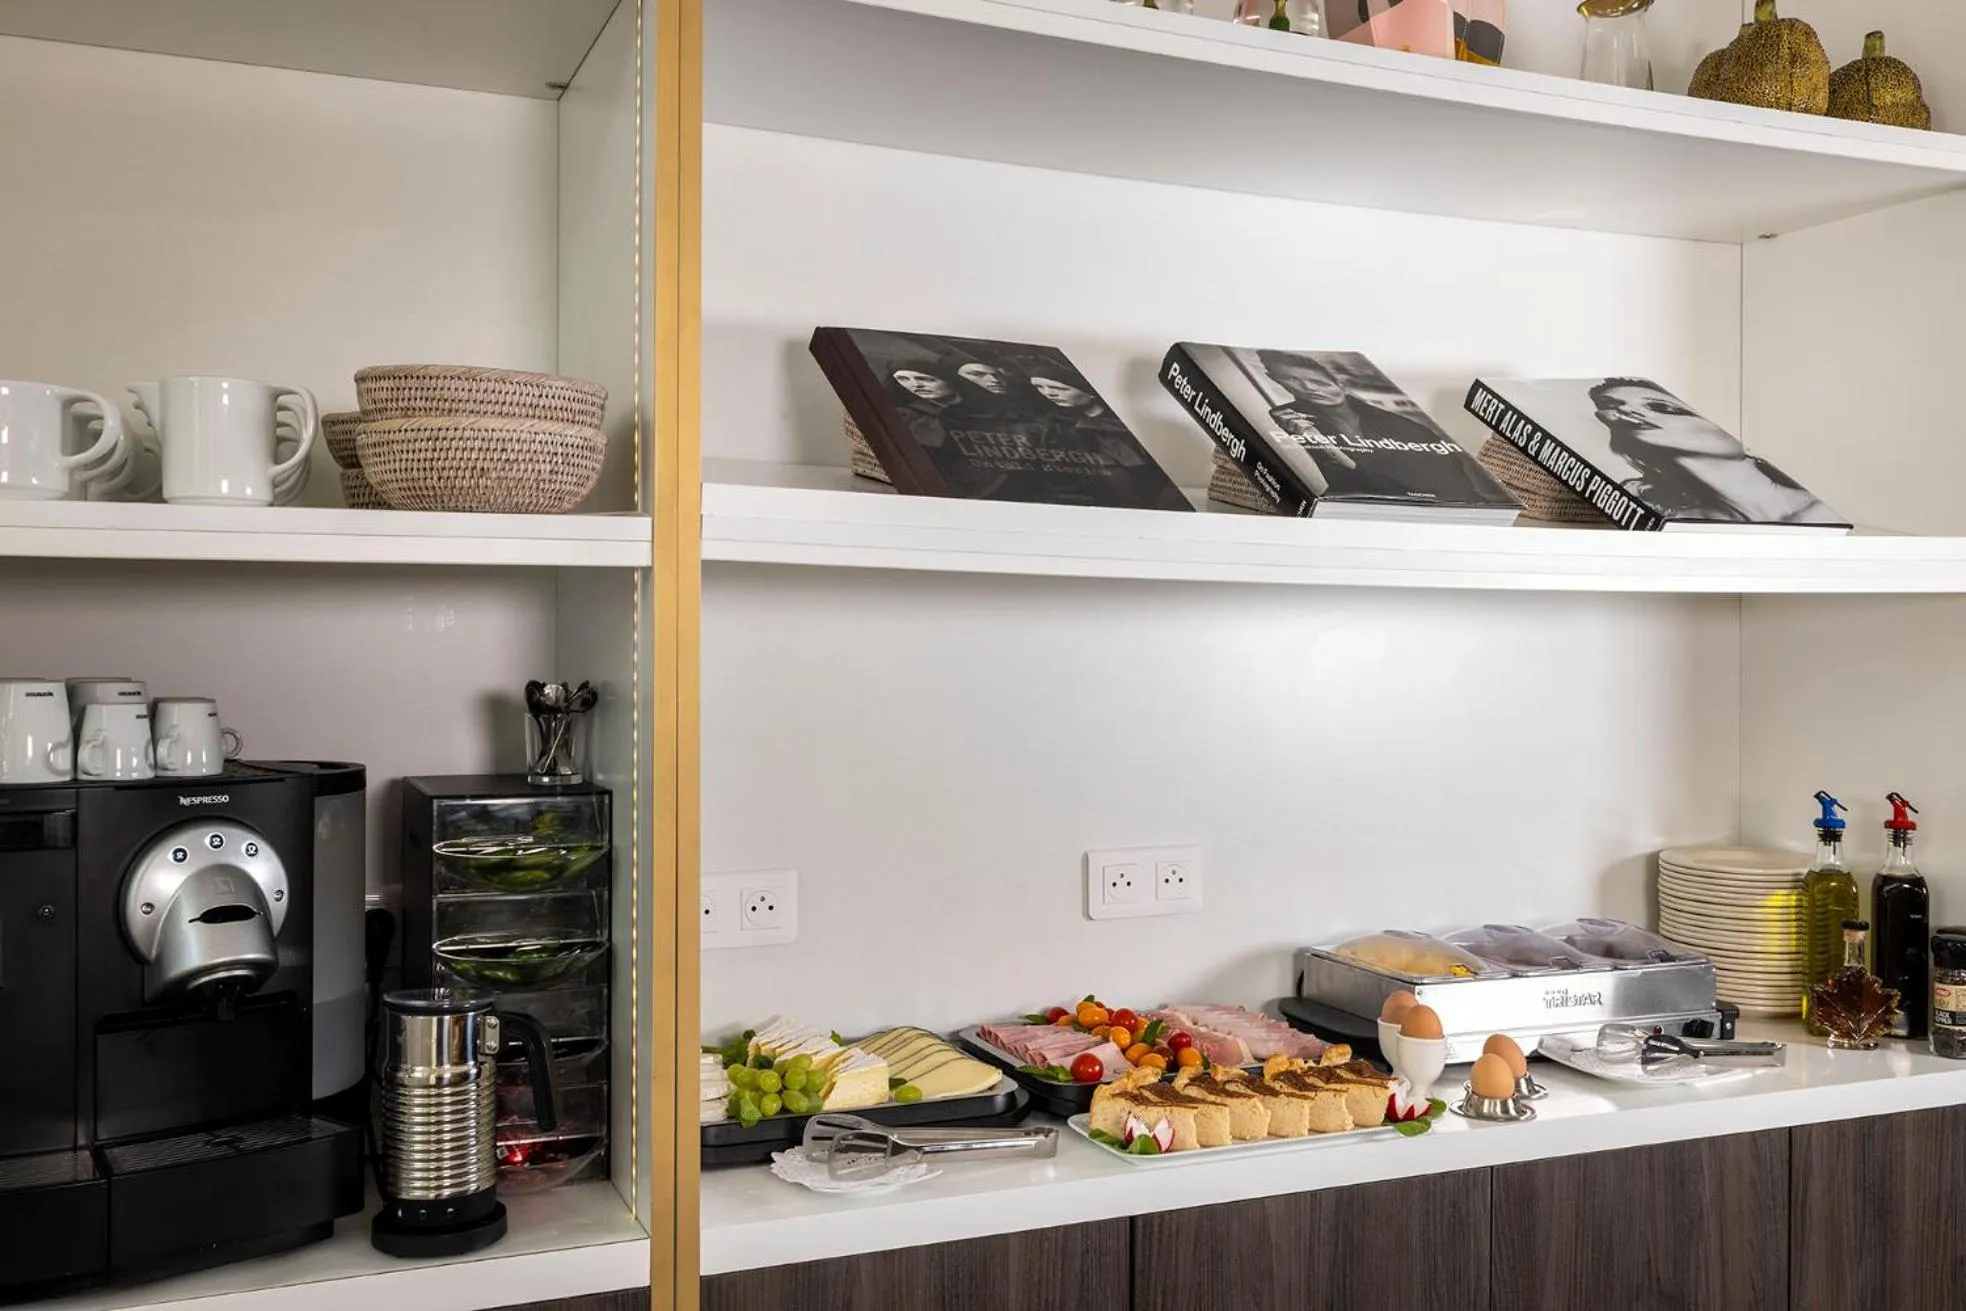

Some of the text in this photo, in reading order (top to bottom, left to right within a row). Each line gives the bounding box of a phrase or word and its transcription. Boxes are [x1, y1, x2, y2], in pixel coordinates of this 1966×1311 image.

[1168, 362, 1247, 462] Peter Lindbergh
[950, 429, 1032, 447] PETER
[1269, 430, 1338, 445] Peter
[1340, 433, 1463, 456] Lindbergh
[957, 441, 1105, 466] LINDBERGH
[1471, 388, 1505, 425] MERT
[1499, 410, 1532, 447] ALAS
[1528, 431, 1542, 457] &
[1538, 438, 1591, 496] MARCUS
[1585, 475, 1645, 531] PIGGOTT
[178, 795, 230, 806] NESPRESSO
